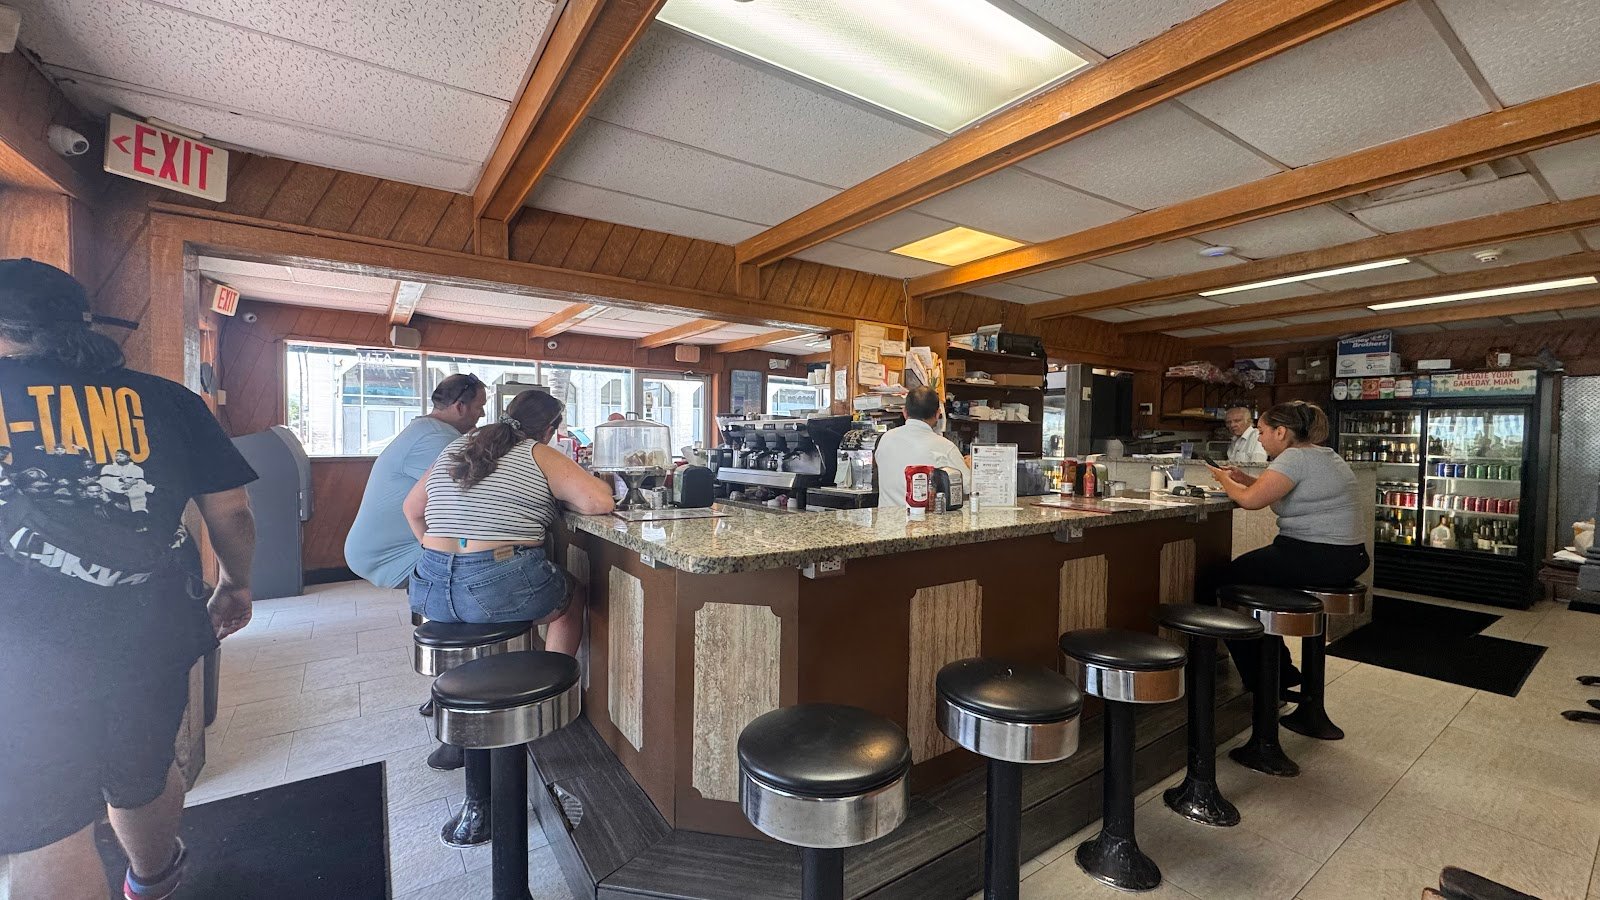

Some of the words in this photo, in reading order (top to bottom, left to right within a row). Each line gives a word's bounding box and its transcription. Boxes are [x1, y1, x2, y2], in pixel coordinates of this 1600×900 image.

[134, 124, 213, 190] EXIT
[217, 287, 238, 313] EXIT
[1492, 371, 1513, 379] YOUR
[1493, 378, 1520, 386] MIAMI
